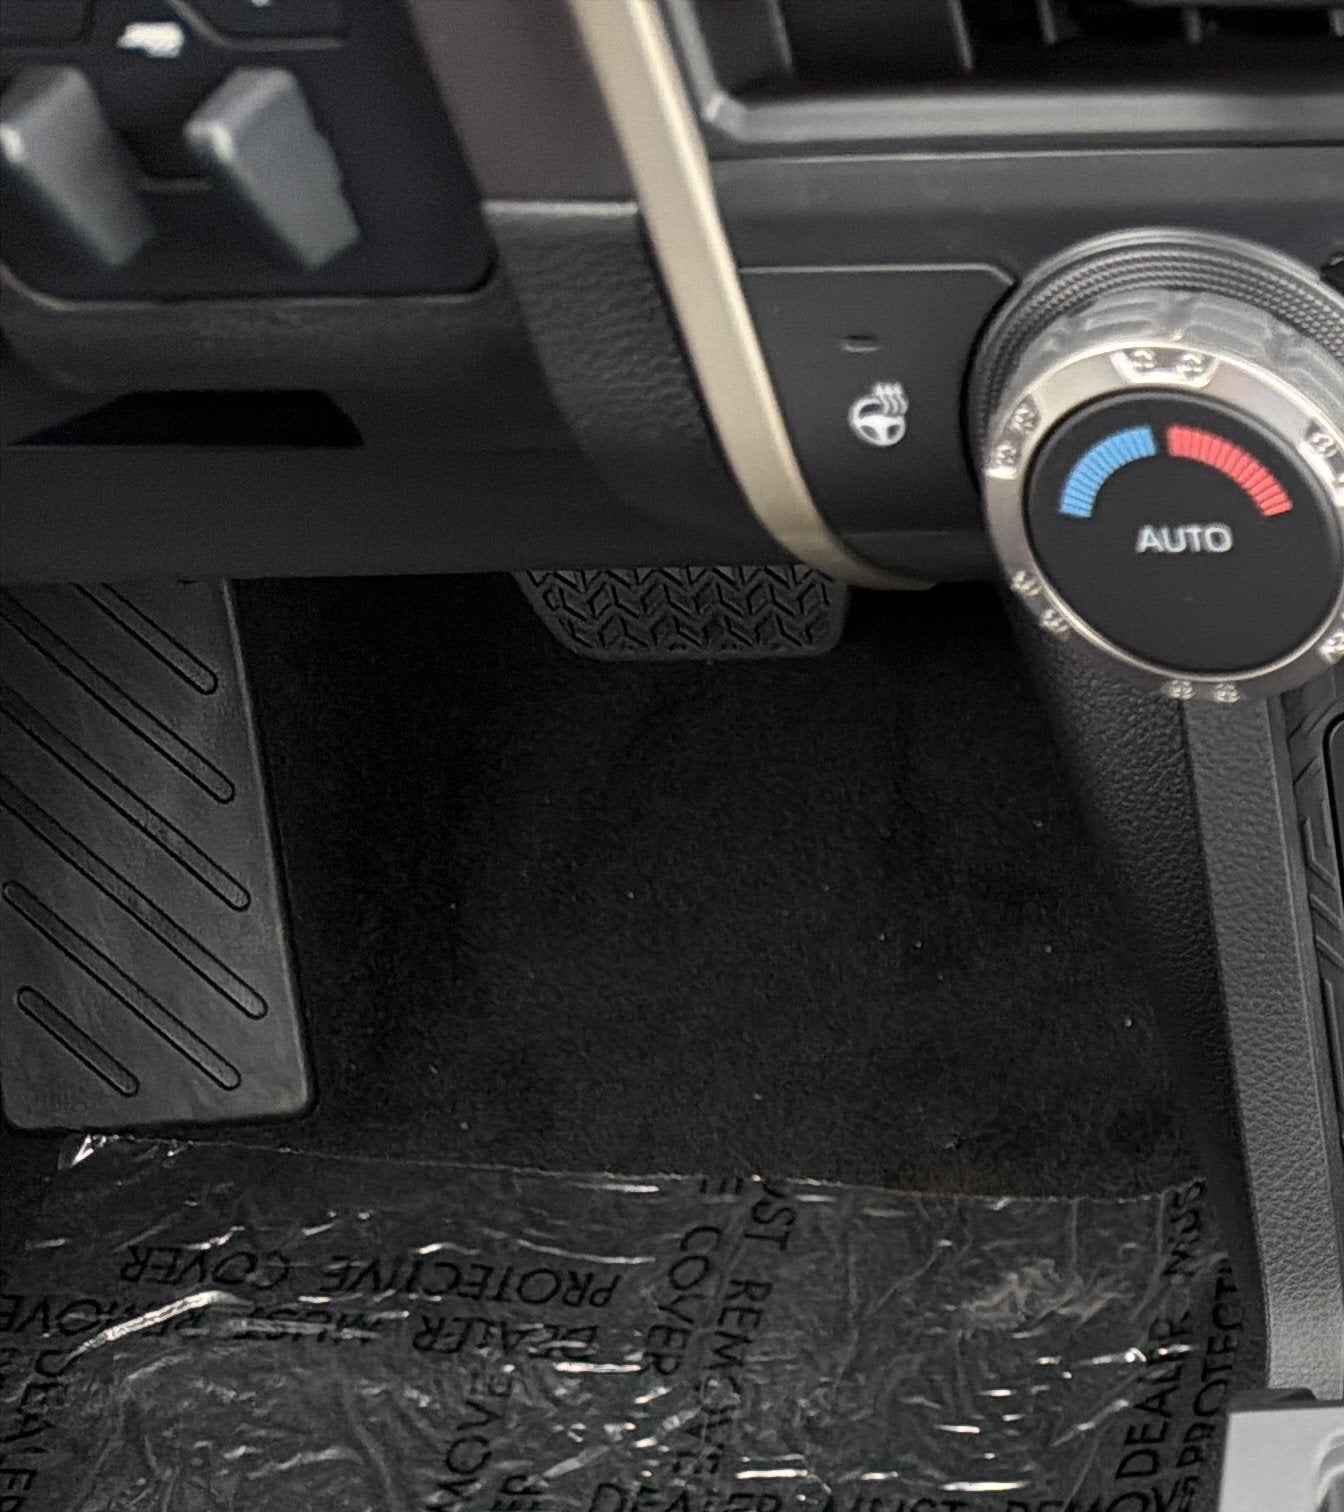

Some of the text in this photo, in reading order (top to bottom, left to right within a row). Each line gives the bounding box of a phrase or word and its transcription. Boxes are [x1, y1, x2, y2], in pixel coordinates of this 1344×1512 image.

[1134, 523, 1234, 554] AUTO
[120, 1243, 622, 1307] PROTECTIVE COVER
[643, 1226, 721, 1378] COVER
